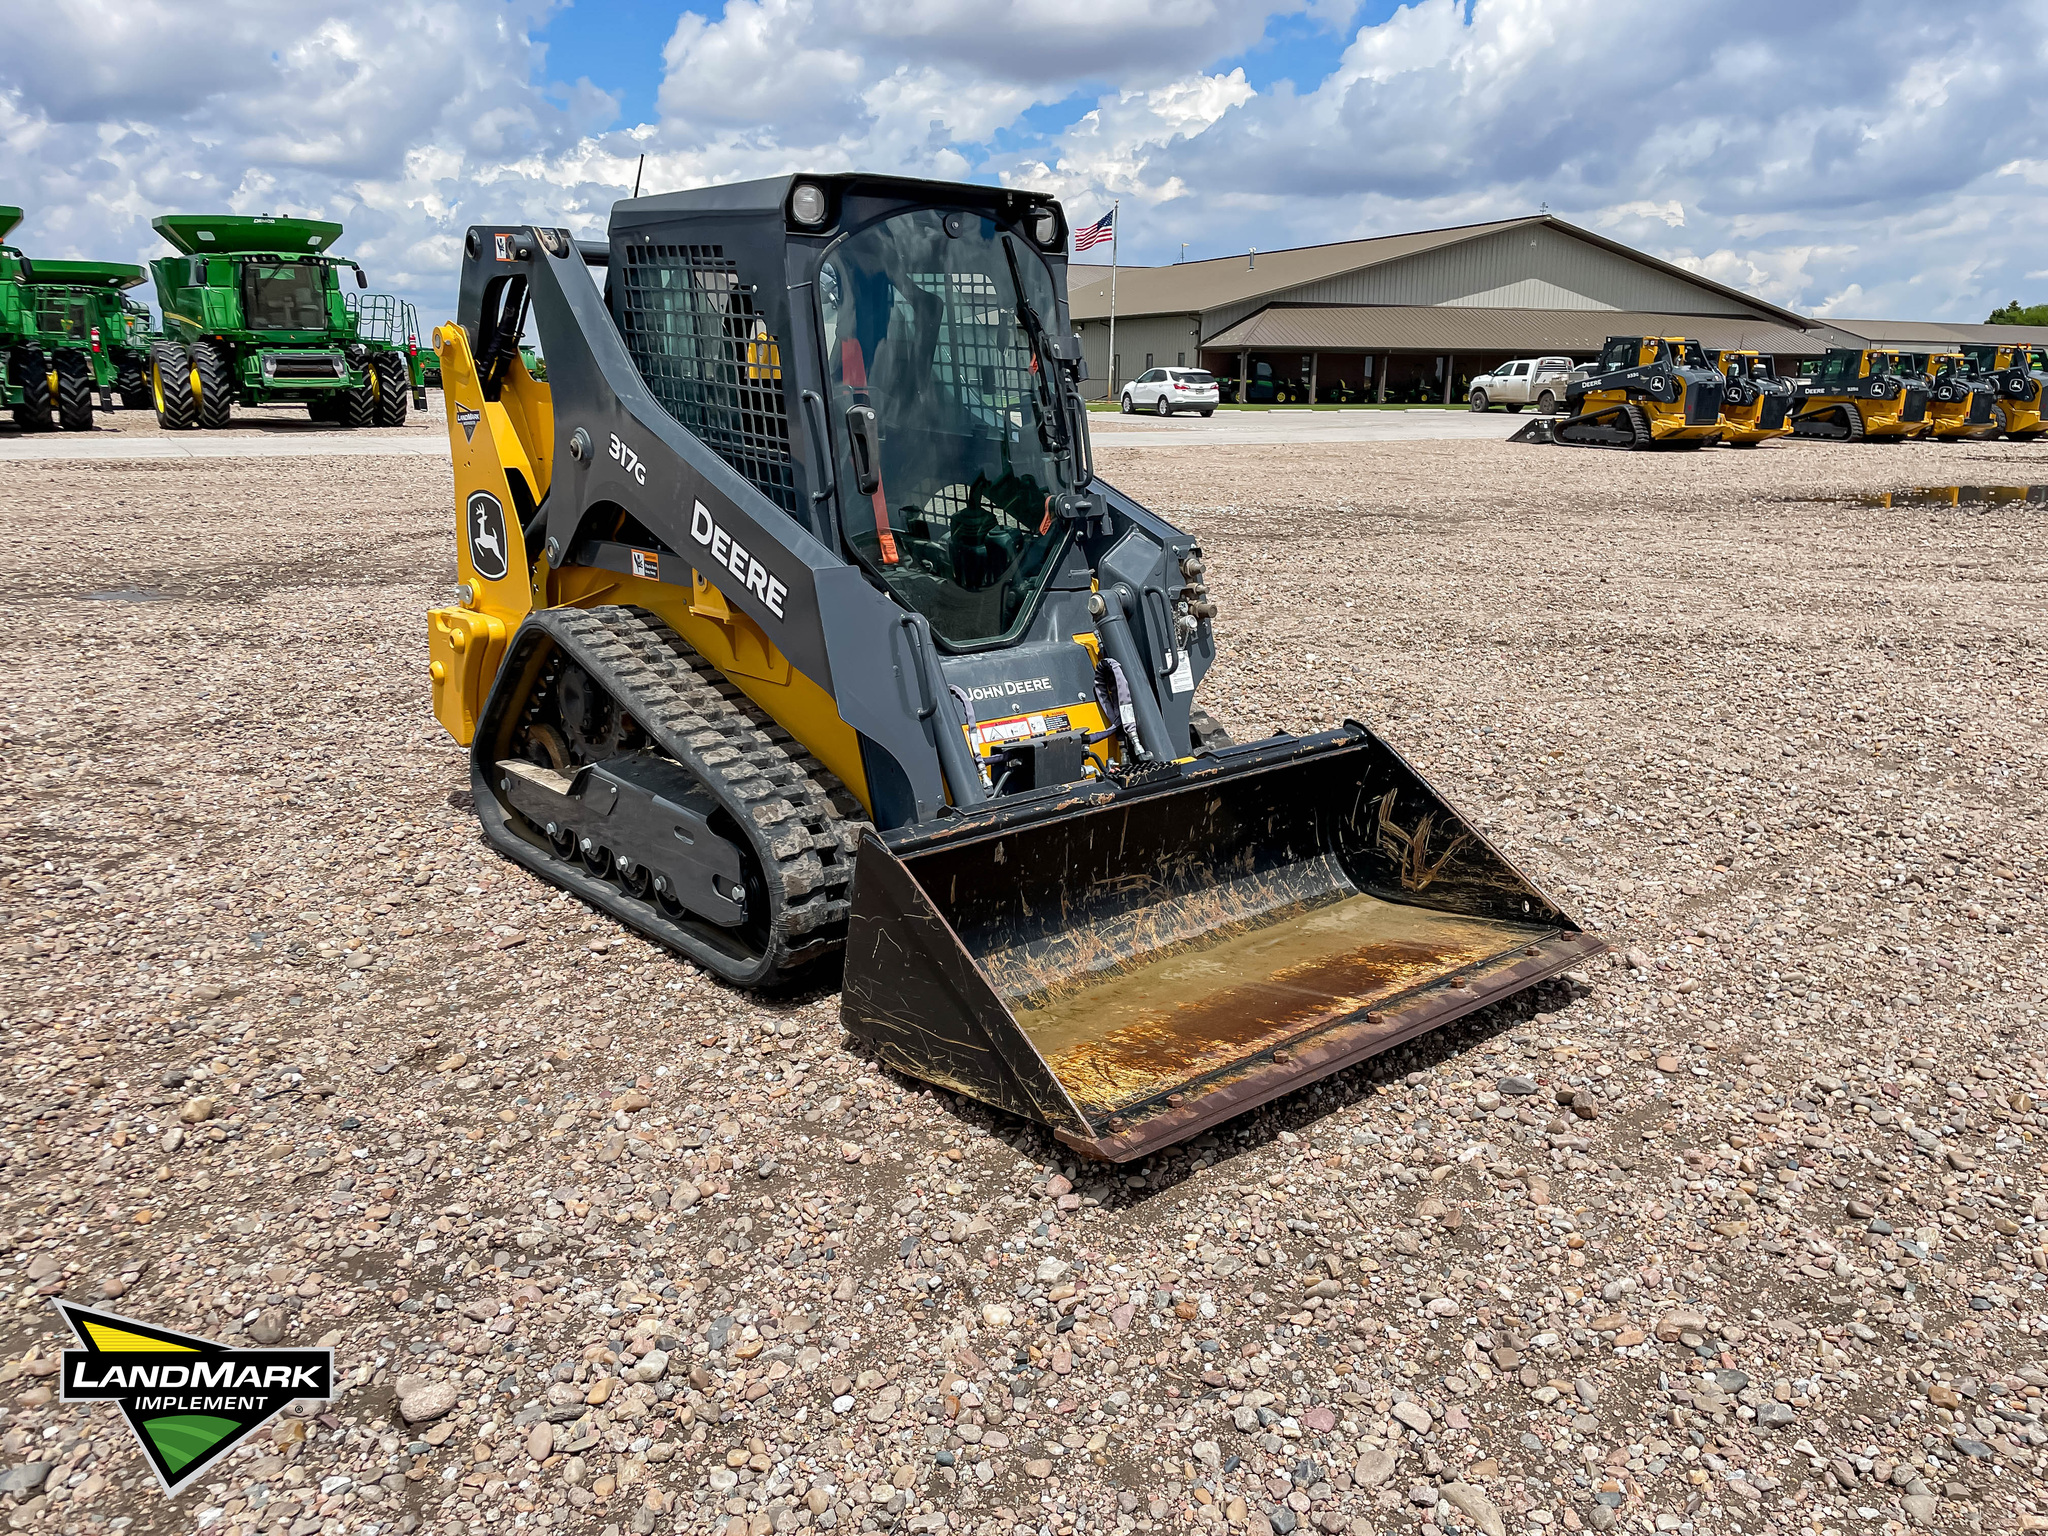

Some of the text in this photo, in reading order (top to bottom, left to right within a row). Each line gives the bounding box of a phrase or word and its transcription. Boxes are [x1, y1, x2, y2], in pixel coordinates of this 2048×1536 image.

[1581, 379, 1603, 389] DEERE
[1804, 387, 1826, 395] DEERE
[608, 431, 647, 487] 317G
[690, 498, 788, 619] DEERE
[967, 677, 1053, 702] JOHN DEERE
